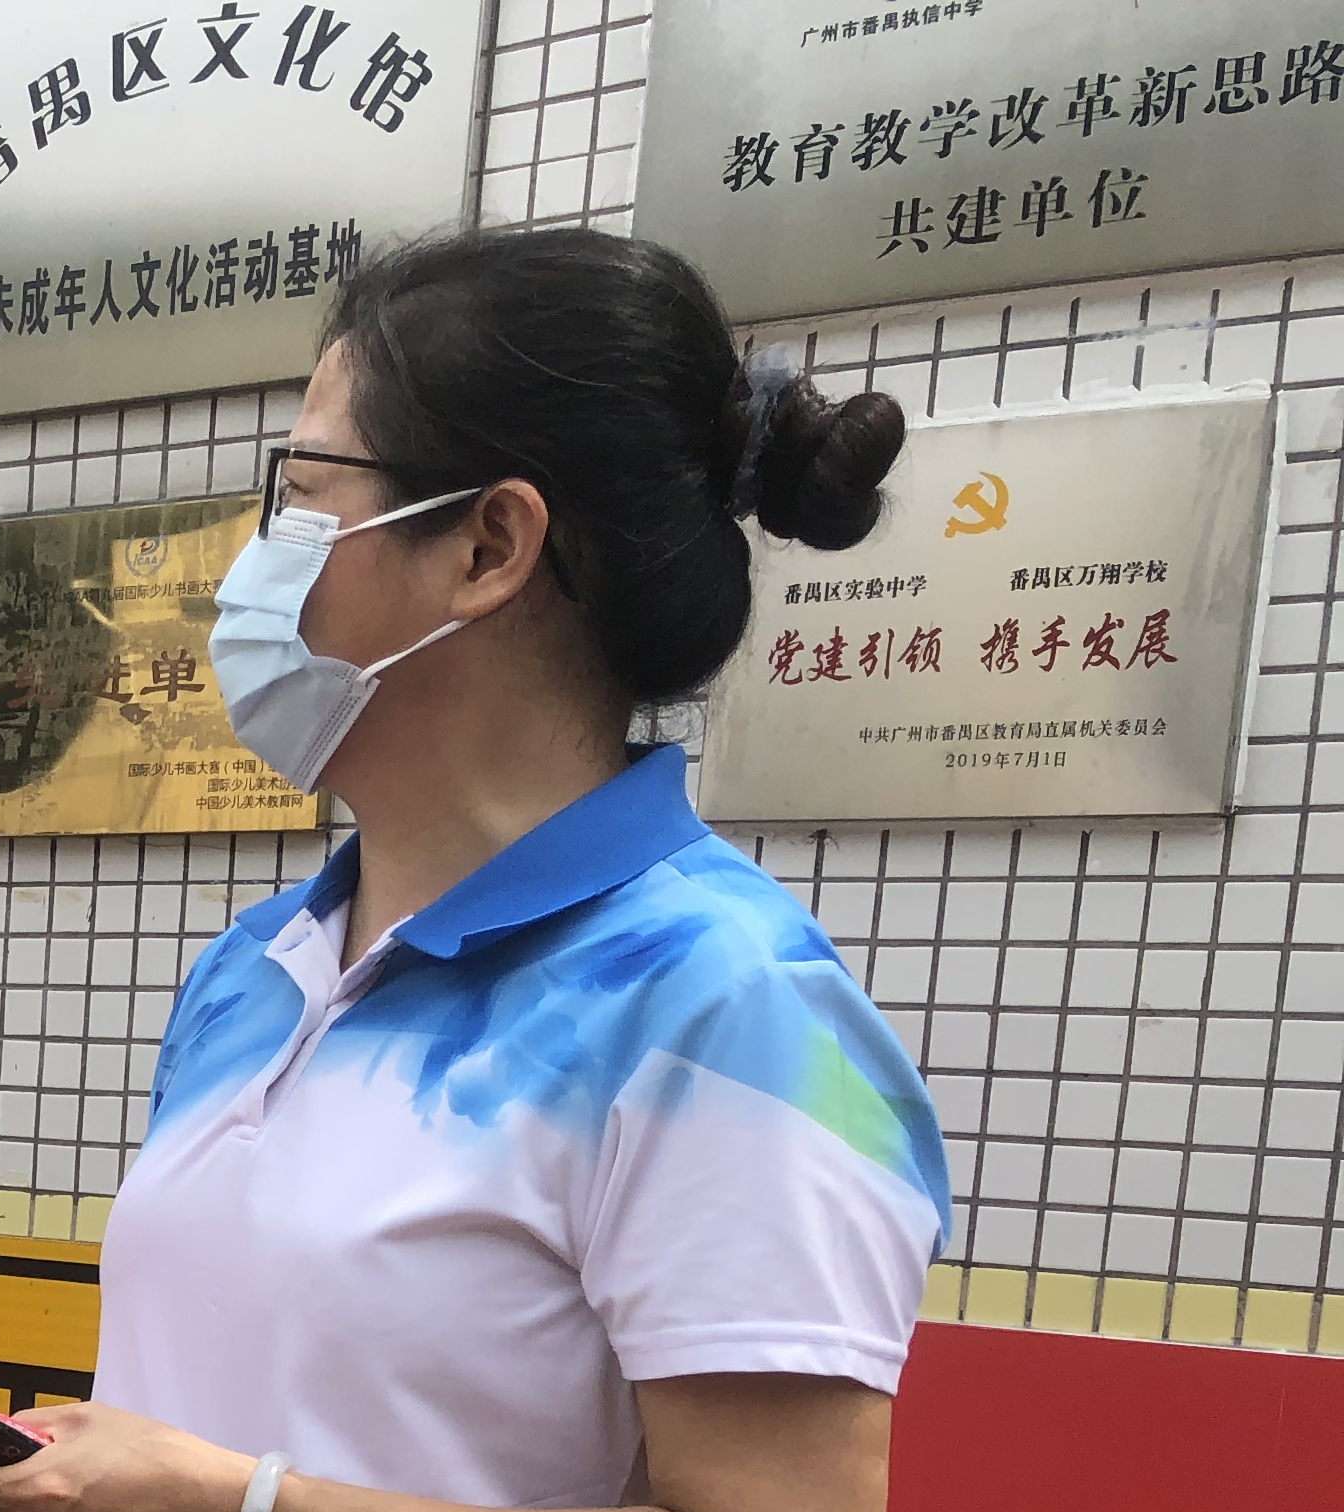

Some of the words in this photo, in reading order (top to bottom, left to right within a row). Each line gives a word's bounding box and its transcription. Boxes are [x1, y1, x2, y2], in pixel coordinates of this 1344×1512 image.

[800, 0, 983, 48] 广州市番禺执信中学
[722, 40, 1344, 193] 教育教学改革新思路
[876, 167, 1149, 260] 共建单位
[784, 575, 928, 605] 番禺区实验中学
[1009, 559, 1169, 593] 番禺区万翔学校
[768, 625, 943, 686] 党建引领
[980, 608, 1179, 676] 携手发展
[858, 717, 1169, 744] 中共广州市番禺区教育局直属机关委员会
[945, 750, 1068, 770] 2019年7月1日
